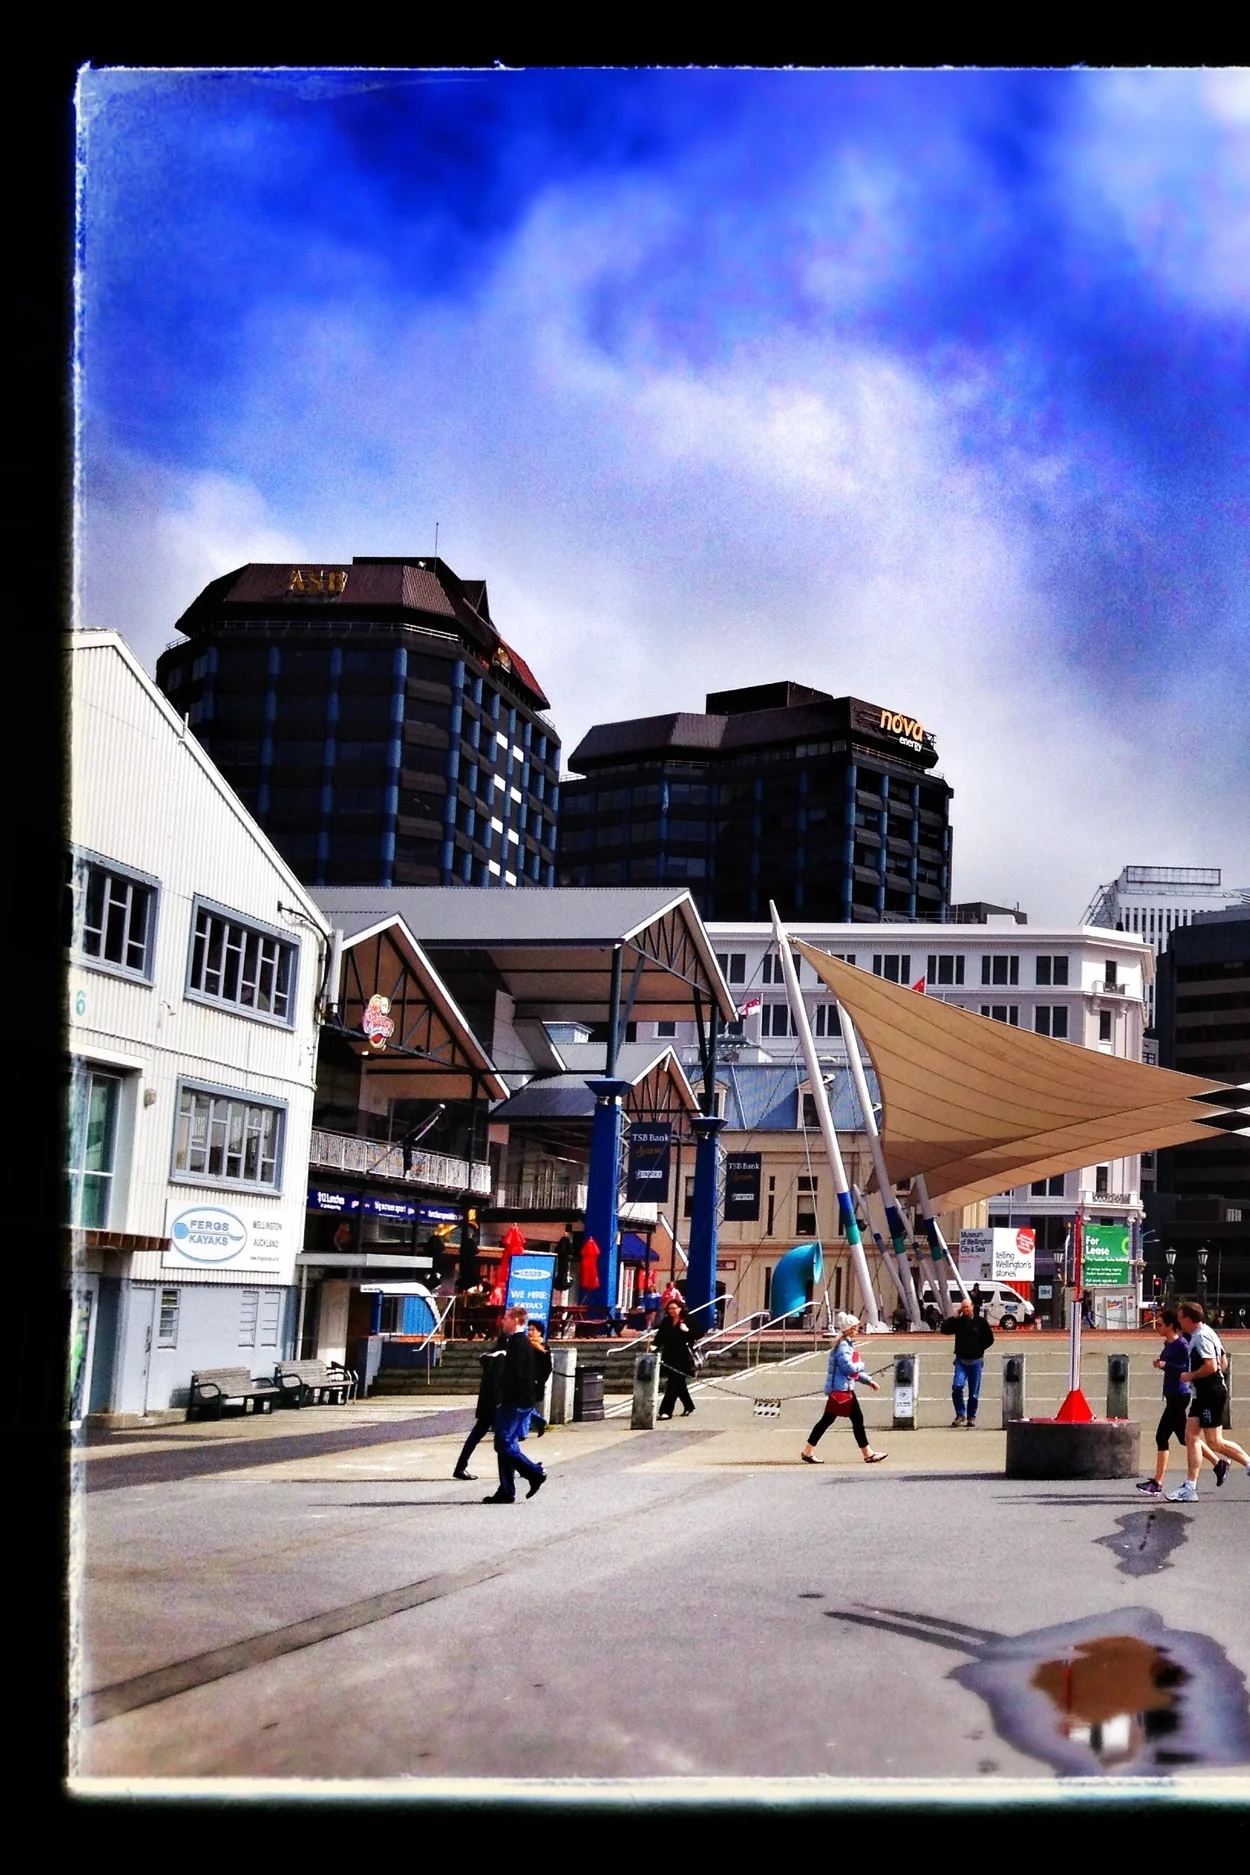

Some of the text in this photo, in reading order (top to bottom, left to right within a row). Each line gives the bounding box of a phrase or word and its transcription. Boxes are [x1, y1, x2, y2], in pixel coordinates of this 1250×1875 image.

[880, 710, 924, 742] nova
[899, 736, 923, 752] energy
[76, 989, 86, 1016] 6
[632, 1133, 669, 1142] TSB Bank
[728, 1162, 760, 1170] TSB Bank
[190, 1220, 229, 1231] FERGS
[188, 1235, 229, 1246] KAYAKS
[1085, 1236, 1099, 1245] For
[1085, 1246, 1110, 1256] Lease
[996, 1260, 1031, 1270] Wellington's
[511, 1290, 524, 1298] WE
